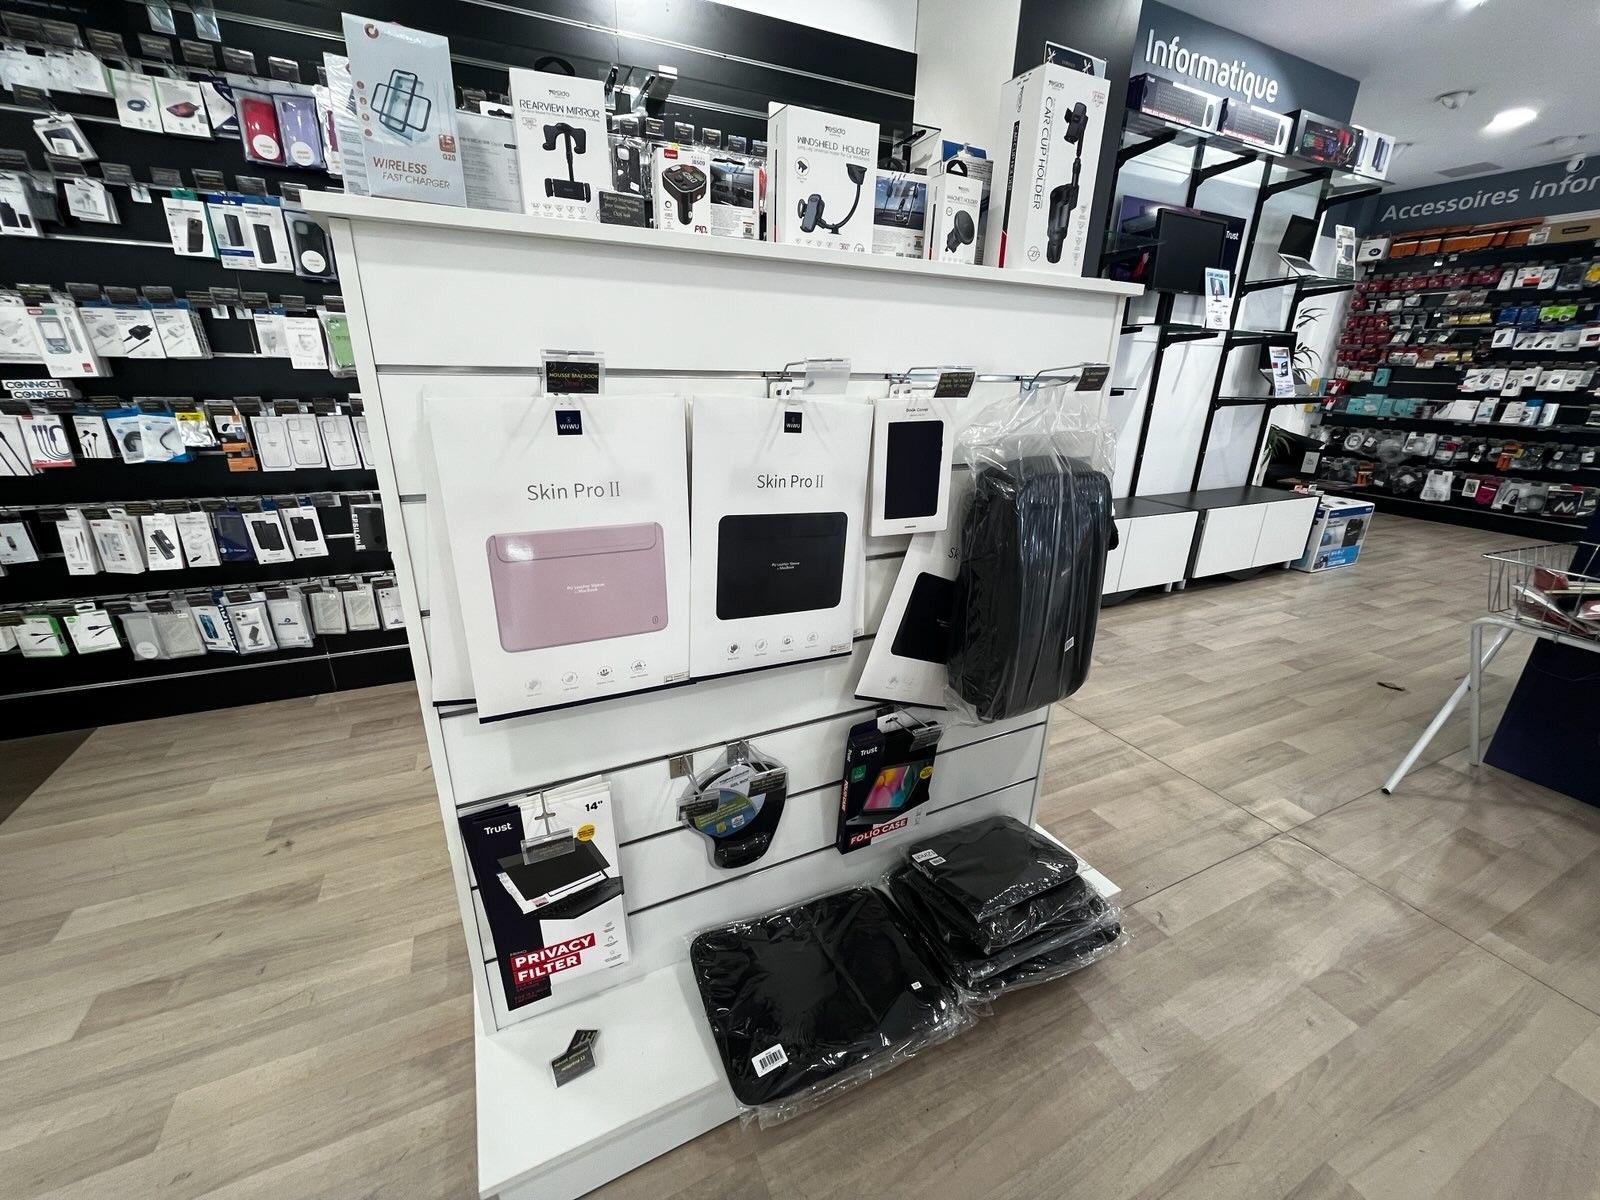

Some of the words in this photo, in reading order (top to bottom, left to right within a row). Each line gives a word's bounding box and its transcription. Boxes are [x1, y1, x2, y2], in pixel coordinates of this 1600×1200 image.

[1145, 28, 1278, 103] Informatique
[519, 99, 564, 113] REARVIEW
[566, 105, 600, 119] MIRROR
[1044, 97, 1054, 125] CAR
[797, 136, 838, 150] WINDSHIELD
[842, 145, 870, 157] HOLDER
[1039, 128, 1050, 156] CUP
[373, 156, 427, 175] WIRELESS
[382, 171, 404, 184] FAST
[405, 175, 450, 190] CHARGER
[1033, 158, 1046, 210] HOLDER
[1381, 188, 1520, 222] Accessoires
[1226, 230, 1239, 240] Trust
[14, 390, 68, 398] CONNECT
[527, 483, 568, 501] Skin
[574, 482, 605, 499] Pro
[757, 474, 786, 489] Skin
[790, 474, 813, 488] Pro
[352, 513, 361, 545] EPSILON
[860, 746, 878, 756] Trust
[484, 822, 513, 835] Trust
[850, 828, 880, 845] FOLIO
[881, 819, 907, 835] CASE
[515, 936, 592, 968] PRIVACY
[518, 955, 580, 982] FILTER
